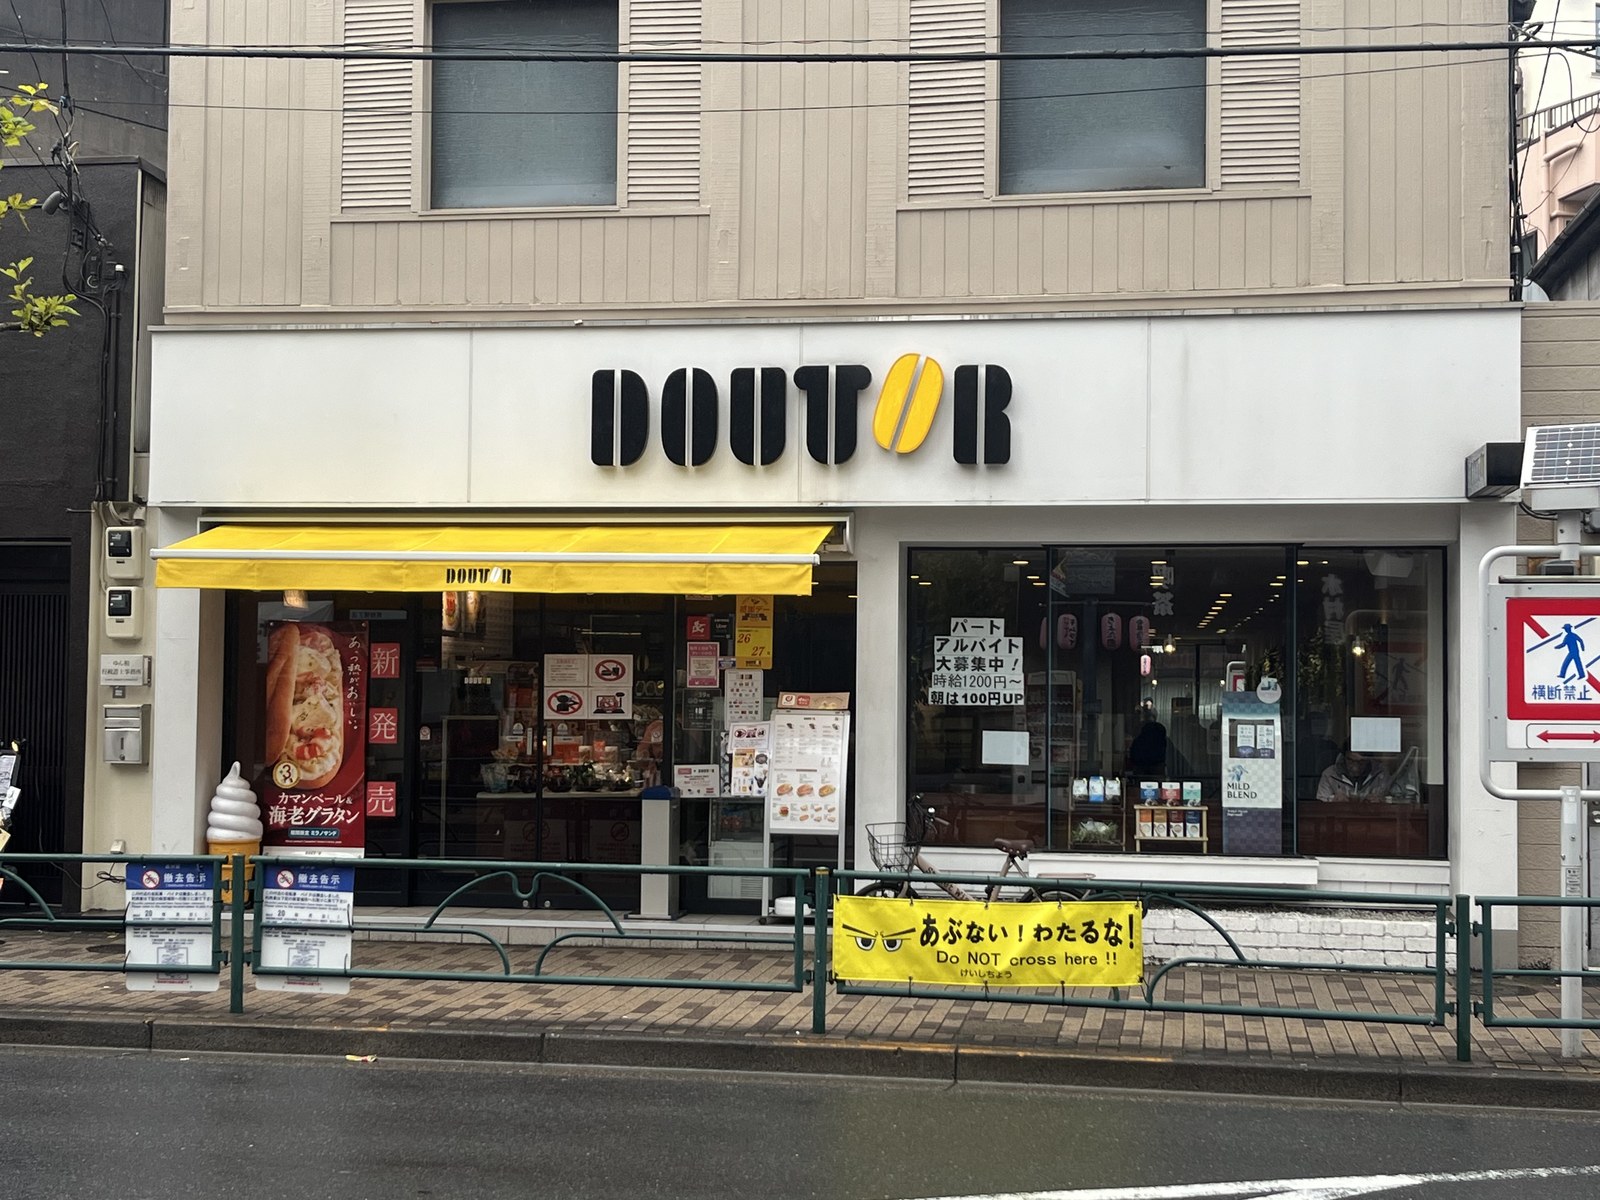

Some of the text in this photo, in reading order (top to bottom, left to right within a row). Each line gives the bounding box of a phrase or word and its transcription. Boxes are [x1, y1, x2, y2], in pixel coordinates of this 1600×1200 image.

[591, 353, 1012, 467] DOUTOR
[446, 567, 512, 584] DOUTOR
[952, 619, 1000, 635] パート
[738, 634, 752, 644] 26
[936, 638, 1019, 653] アルバイト
[752, 646, 766, 656] 27
[936, 657, 1019, 672] 大募集中！
[931, 690, 1024, 705] 朝は100円UP
[1532, 685, 1593, 701] 横断禁止
[1227, 791, 1257, 799] BLEND
[269, 805, 360, 825] 海老グラタン
[164, 872, 207, 884] 撤去告示
[298, 873, 341, 885] 撤去告示
[920, 913, 1134, 949] あぶない！わたるな！
[936, 951, 1117, 966] Do NOT cross here !!
[960, 968, 1012, 978] けいしちょう
